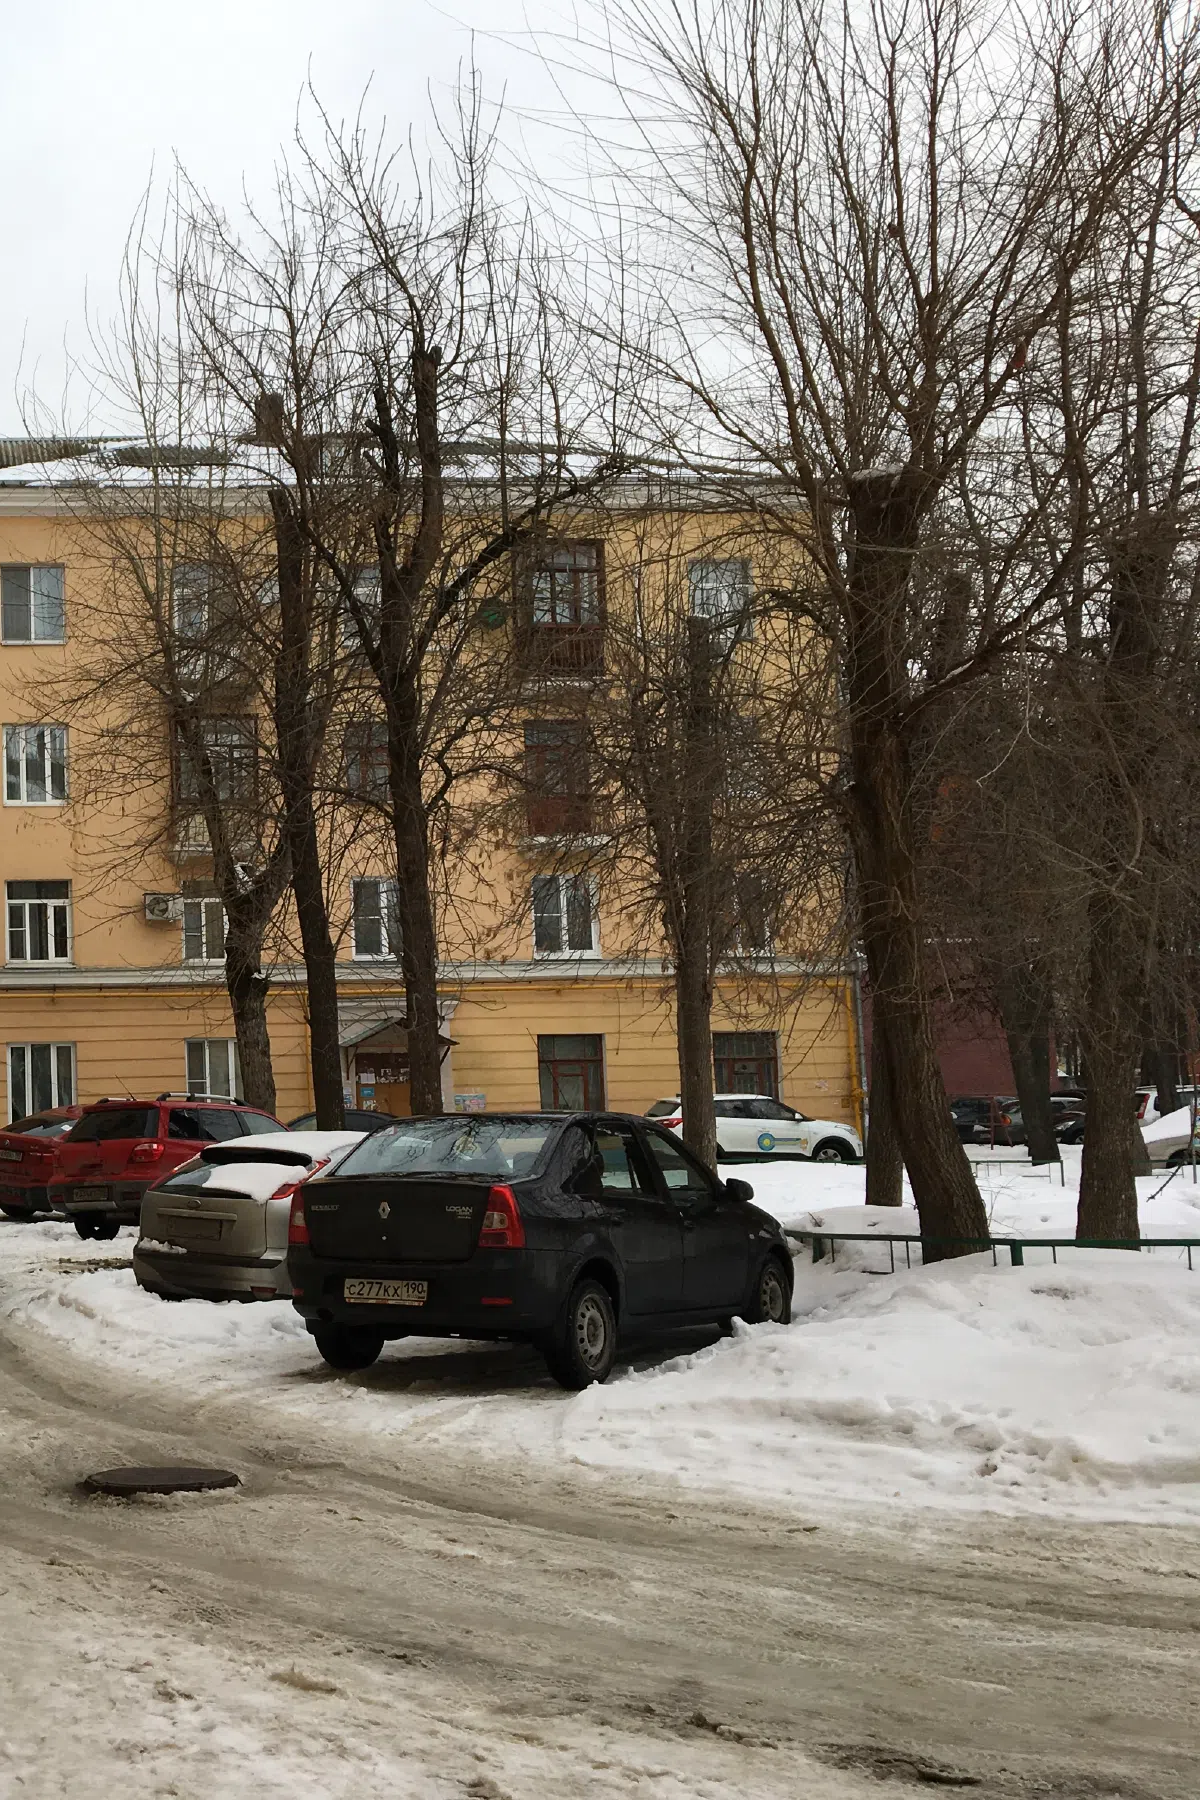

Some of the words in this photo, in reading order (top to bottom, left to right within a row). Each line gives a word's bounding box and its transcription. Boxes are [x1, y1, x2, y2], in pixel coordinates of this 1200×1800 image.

[445, 1205, 473, 1213] LOGAN
[348, 1281, 401, 1297] С277КХ
[404, 1282, 424, 1295] 190
